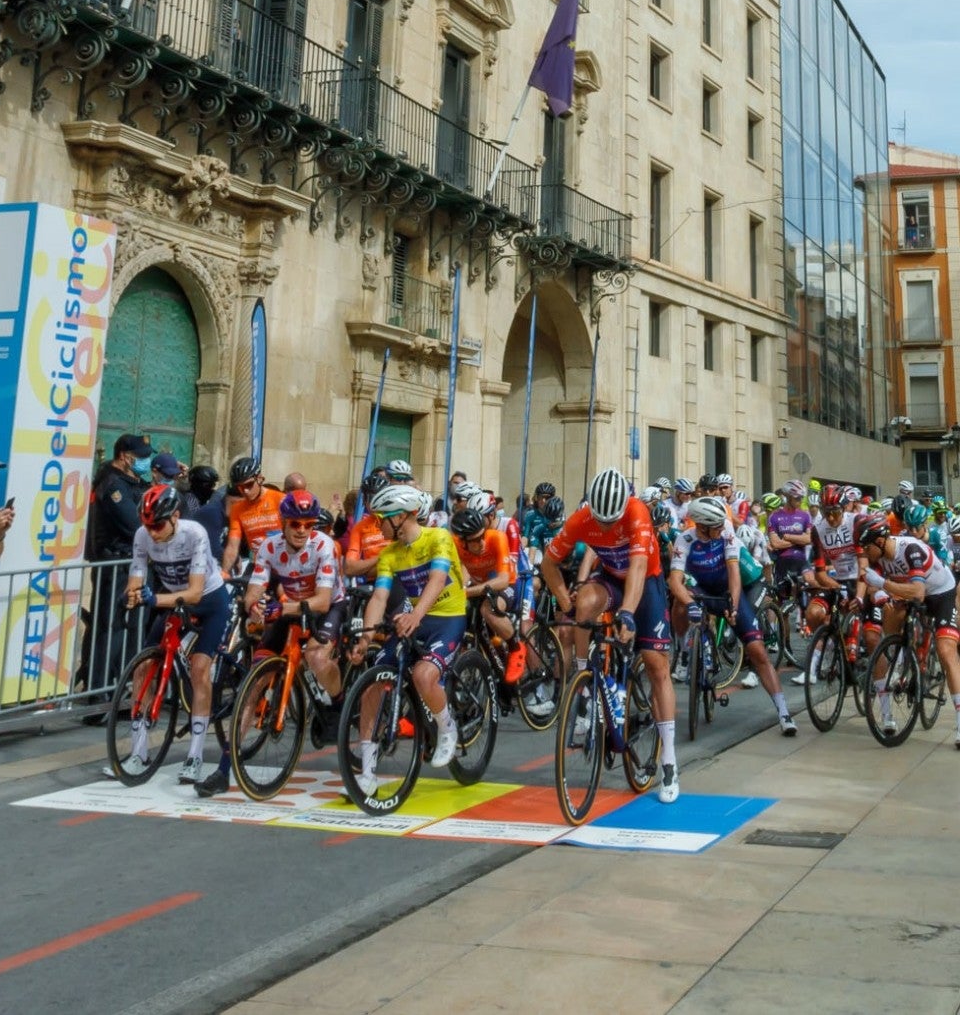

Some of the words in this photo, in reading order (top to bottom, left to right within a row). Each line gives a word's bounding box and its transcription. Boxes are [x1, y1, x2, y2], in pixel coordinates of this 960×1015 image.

[22, 227, 88, 682] #ElArteDelCiclismo
[824, 530, 851, 547] UAE
[364, 795, 399, 810] roval
[307, 815, 410, 830] Sabadell
